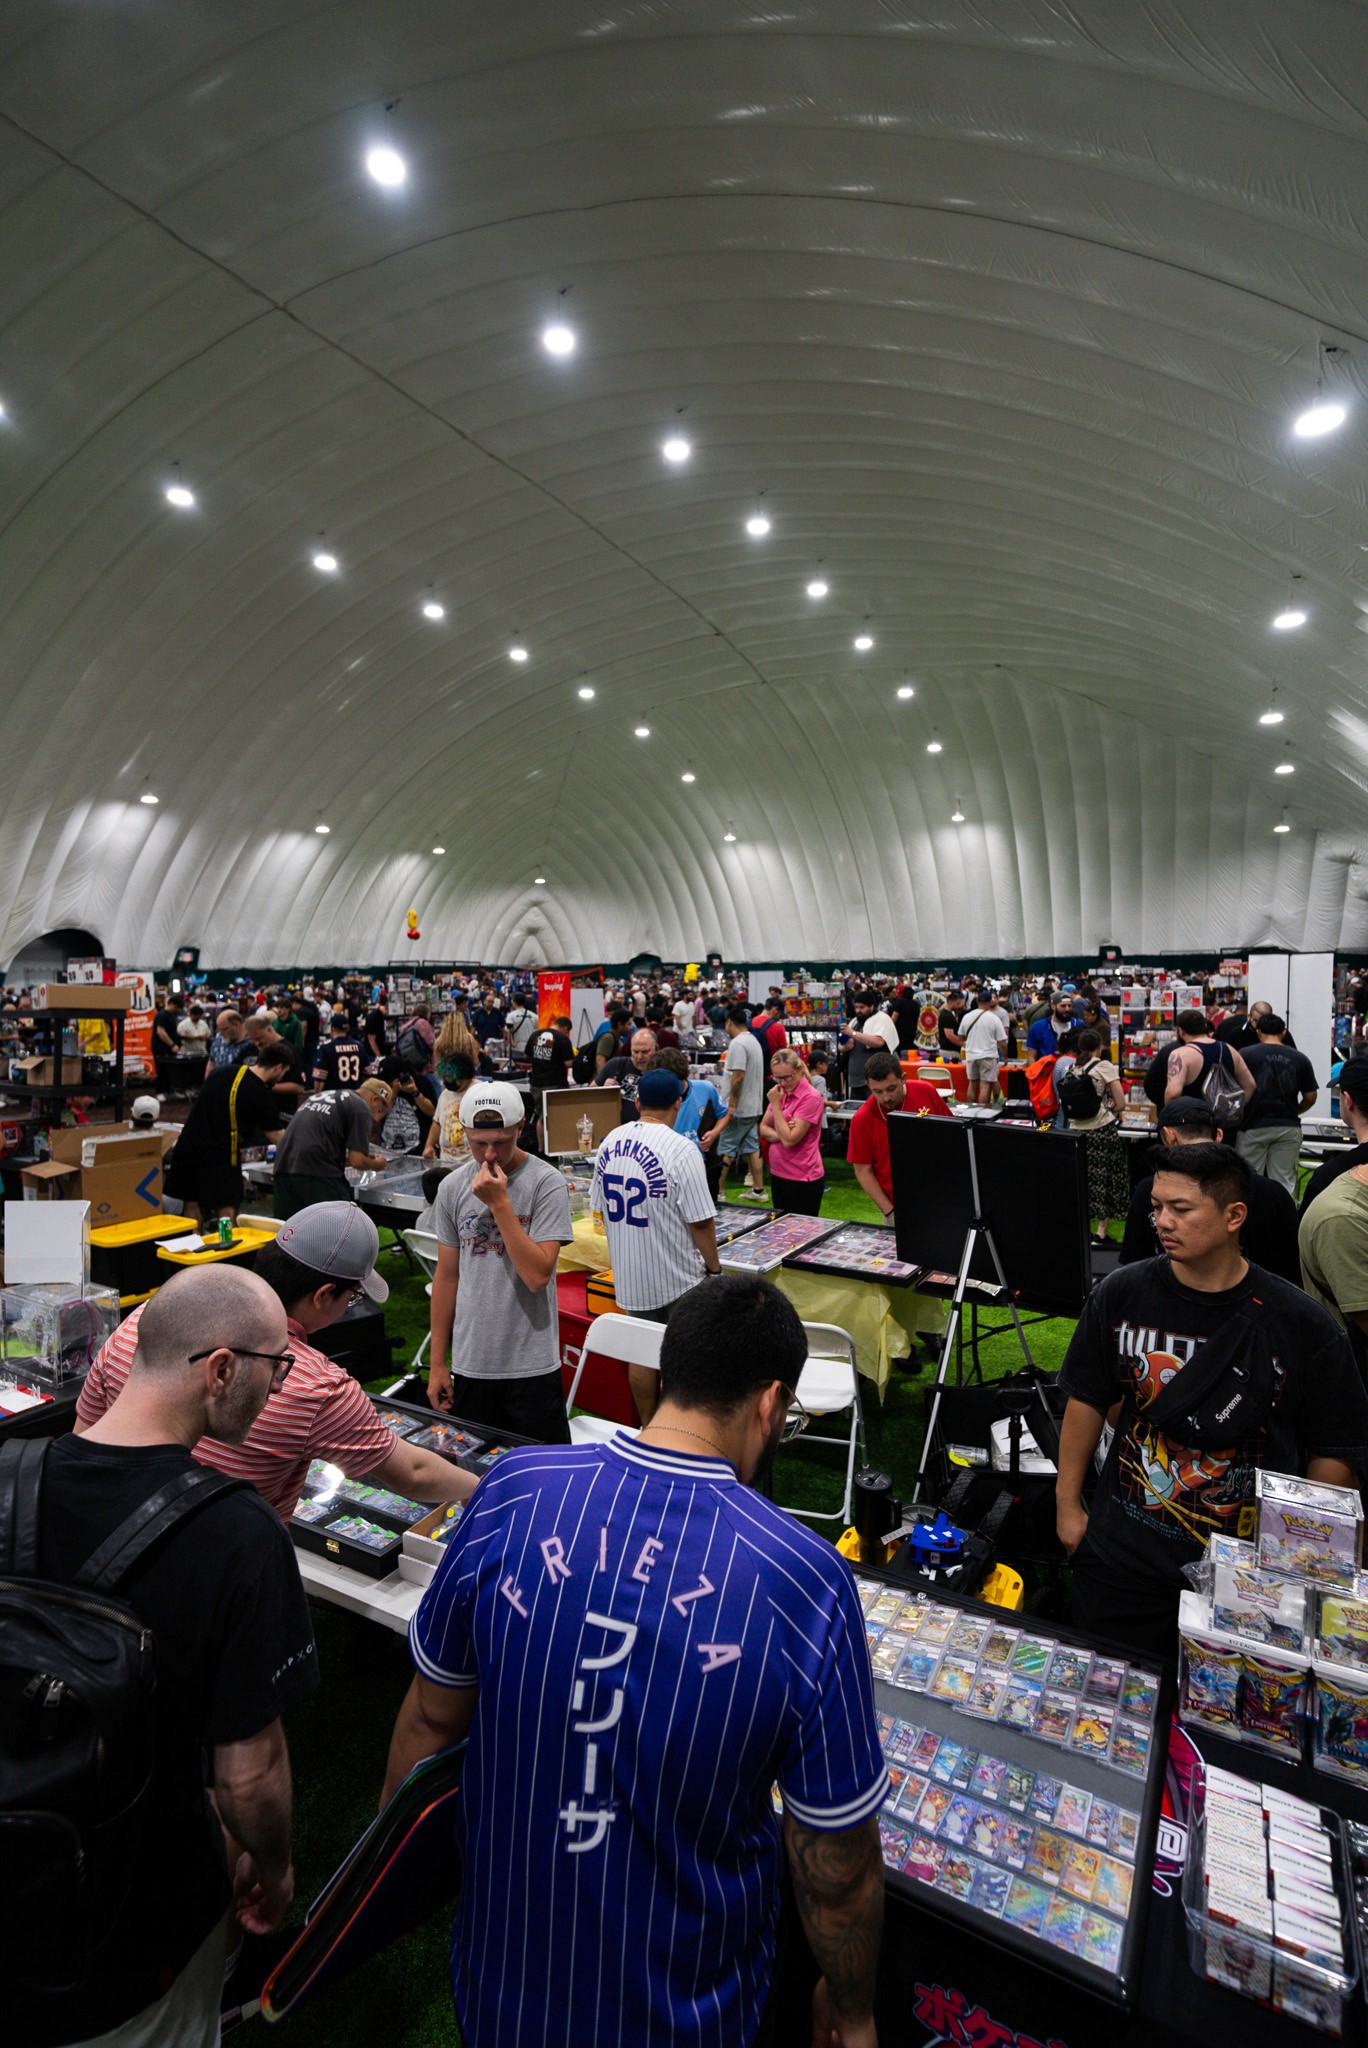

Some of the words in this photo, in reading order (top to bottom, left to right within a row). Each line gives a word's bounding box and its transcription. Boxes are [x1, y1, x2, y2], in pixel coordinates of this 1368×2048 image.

[335, 1044, 359, 1053] BENNETT
[338, 1055, 360, 1082] 83
[475, 1098, 501, 1106] FOOTBALL
[597, 1139, 668, 1198] ROW-ARMSTRONG
[603, 1173, 649, 1228] 52
[282, 1228, 294, 1242] C
[1215, 1393, 1243, 1424] Supreme
[500, 1527, 743, 1675] FRIEZA
[1239, 1642, 1257, 1651] EACH
[558, 1610, 639, 1854] フリーザ
